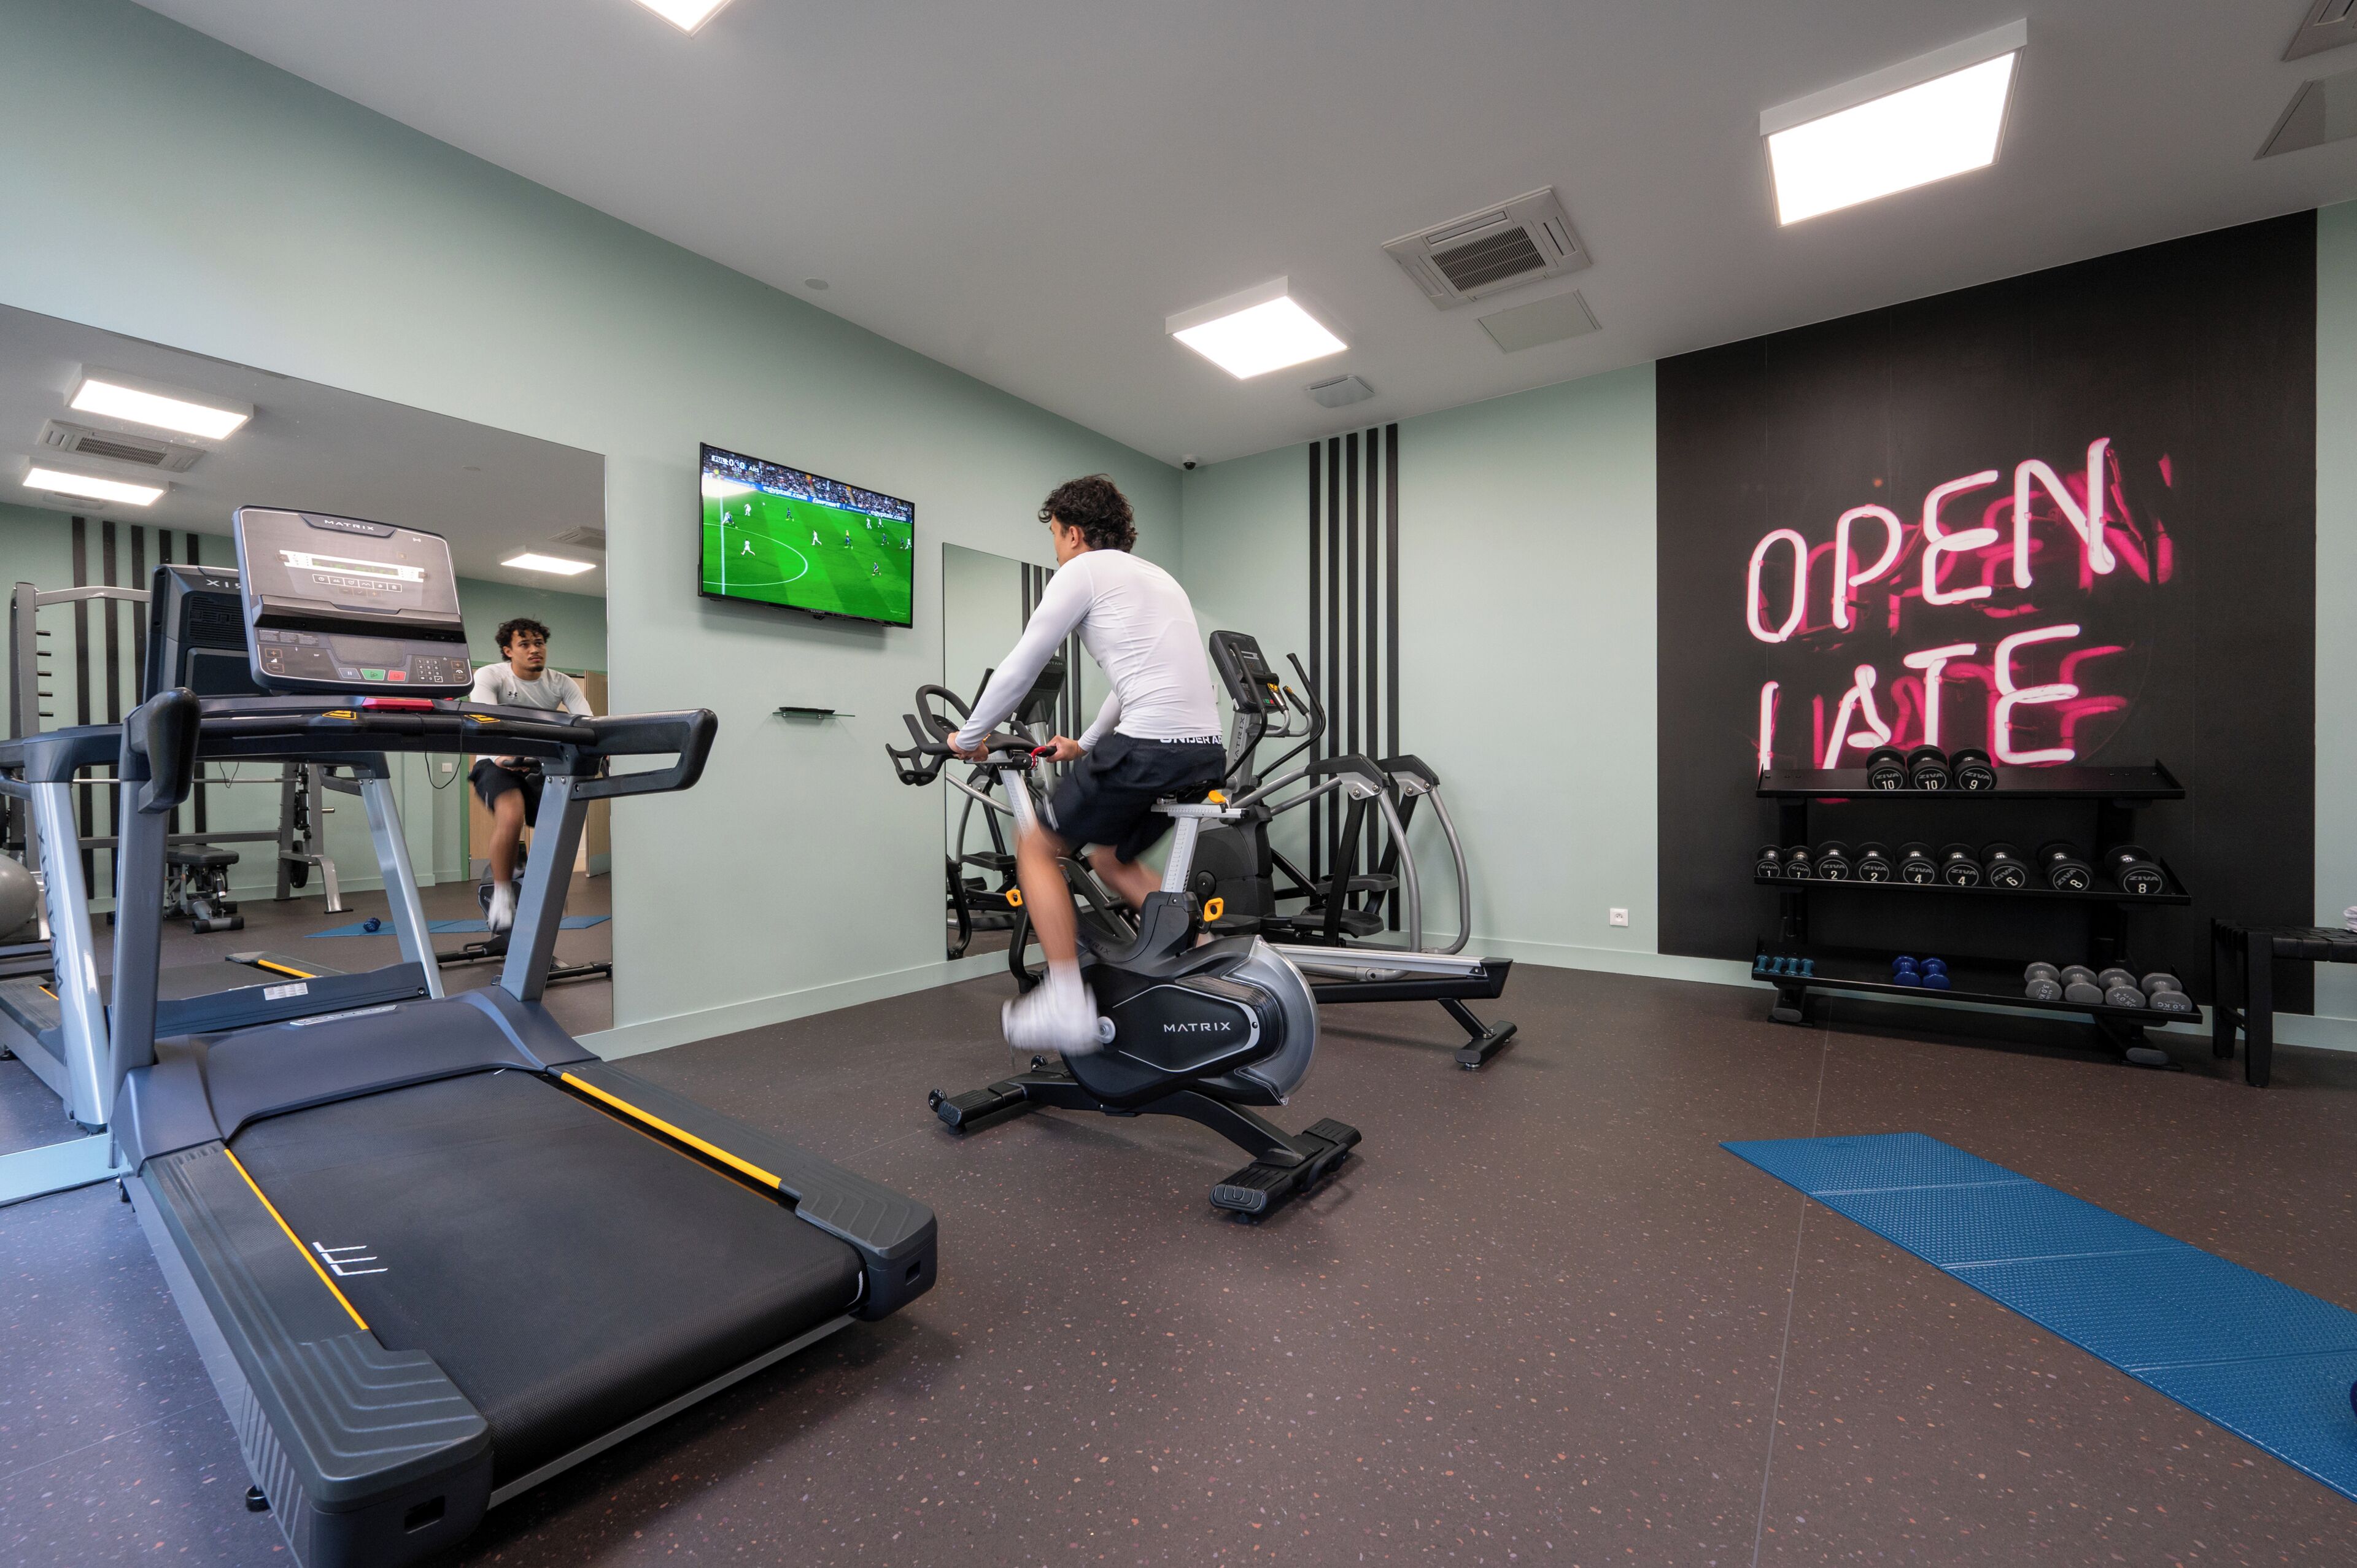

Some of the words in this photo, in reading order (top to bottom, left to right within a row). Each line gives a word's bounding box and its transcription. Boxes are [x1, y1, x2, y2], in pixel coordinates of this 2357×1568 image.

[762, 486, 808, 501] egyptair.com
[870, 511, 907, 521] egyptair.com
[324, 520, 374, 531] MATRIX
[1747, 437, 2116, 643] OPEN
[1965, 771, 1990, 780] ZIVA
[1882, 780, 1895, 790] 10
[1925, 780, 1938, 790] 10
[1969, 780, 1978, 790] 9
[1830, 870, 1838, 879] 2
[1871, 872, 1878, 881] 2
[1914, 874, 1922, 884] 4
[1993, 867, 2016, 882] ZIVA
[2056, 869, 2077, 886] ZIVA
[1957, 876, 1966, 886] 4
[2006, 876, 2018, 886] 6
[2070, 879, 2083, 888] 8
[2138, 883, 2146, 894] 8
[1163, 1022, 1231, 1032] MATRIX
